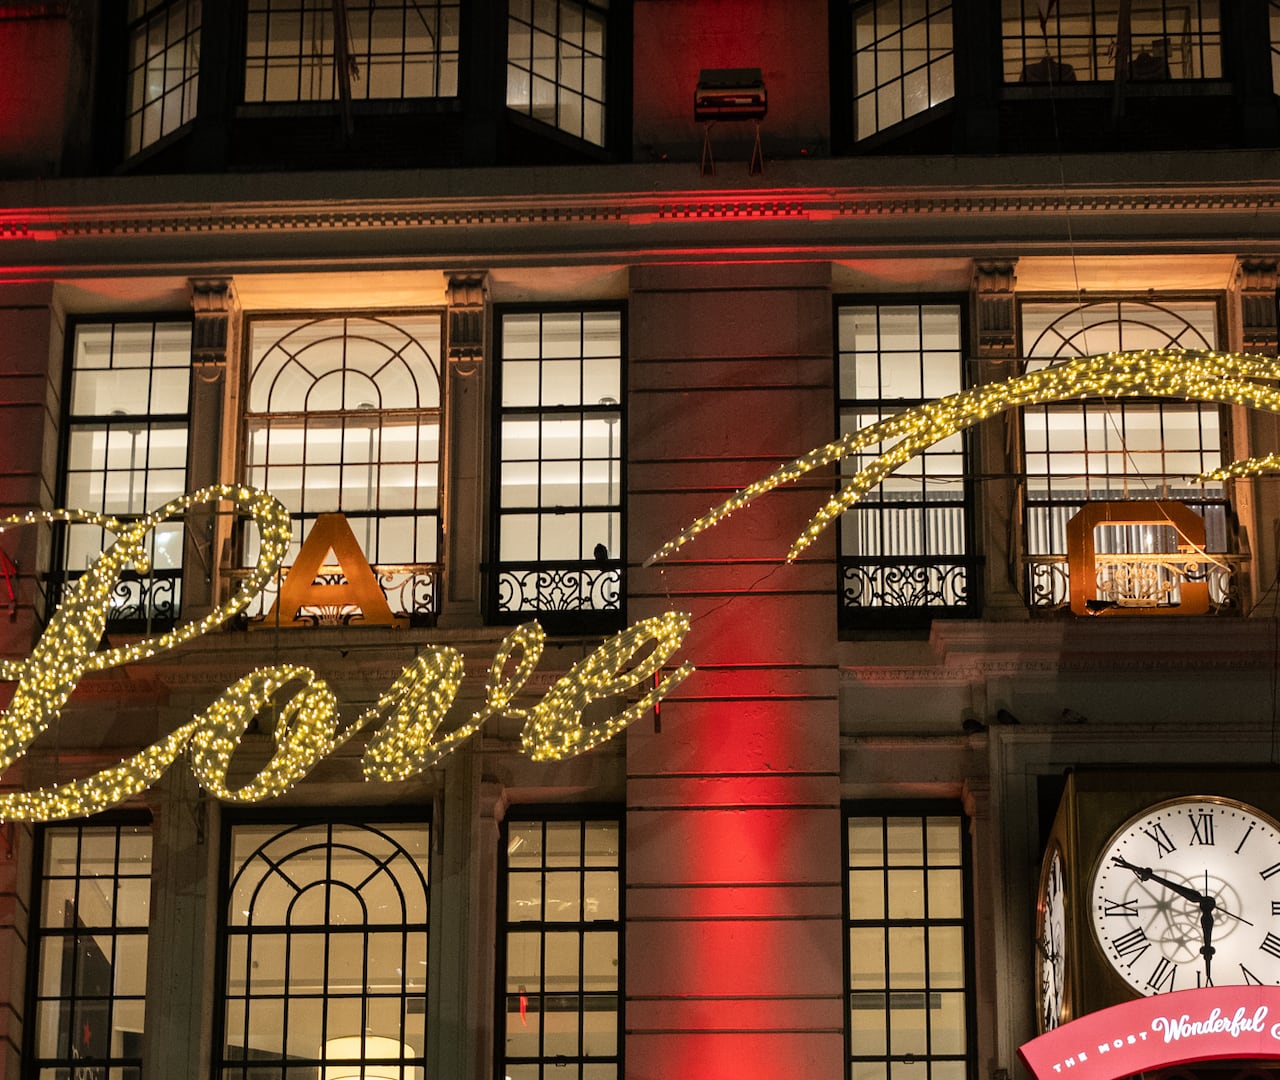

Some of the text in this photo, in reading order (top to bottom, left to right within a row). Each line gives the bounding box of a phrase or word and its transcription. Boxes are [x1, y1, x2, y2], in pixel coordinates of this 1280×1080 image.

[248, 513, 410, 628] A
[1066, 501, 1209, 616] C
[1144, 822, 1177, 858] XI
[1188, 814, 1215, 846] XII
[1053, 1052, 1088, 1073] THE
[1098, 1031, 1148, 1054] MOST
[1151, 1005, 1269, 1044] Wonderful
